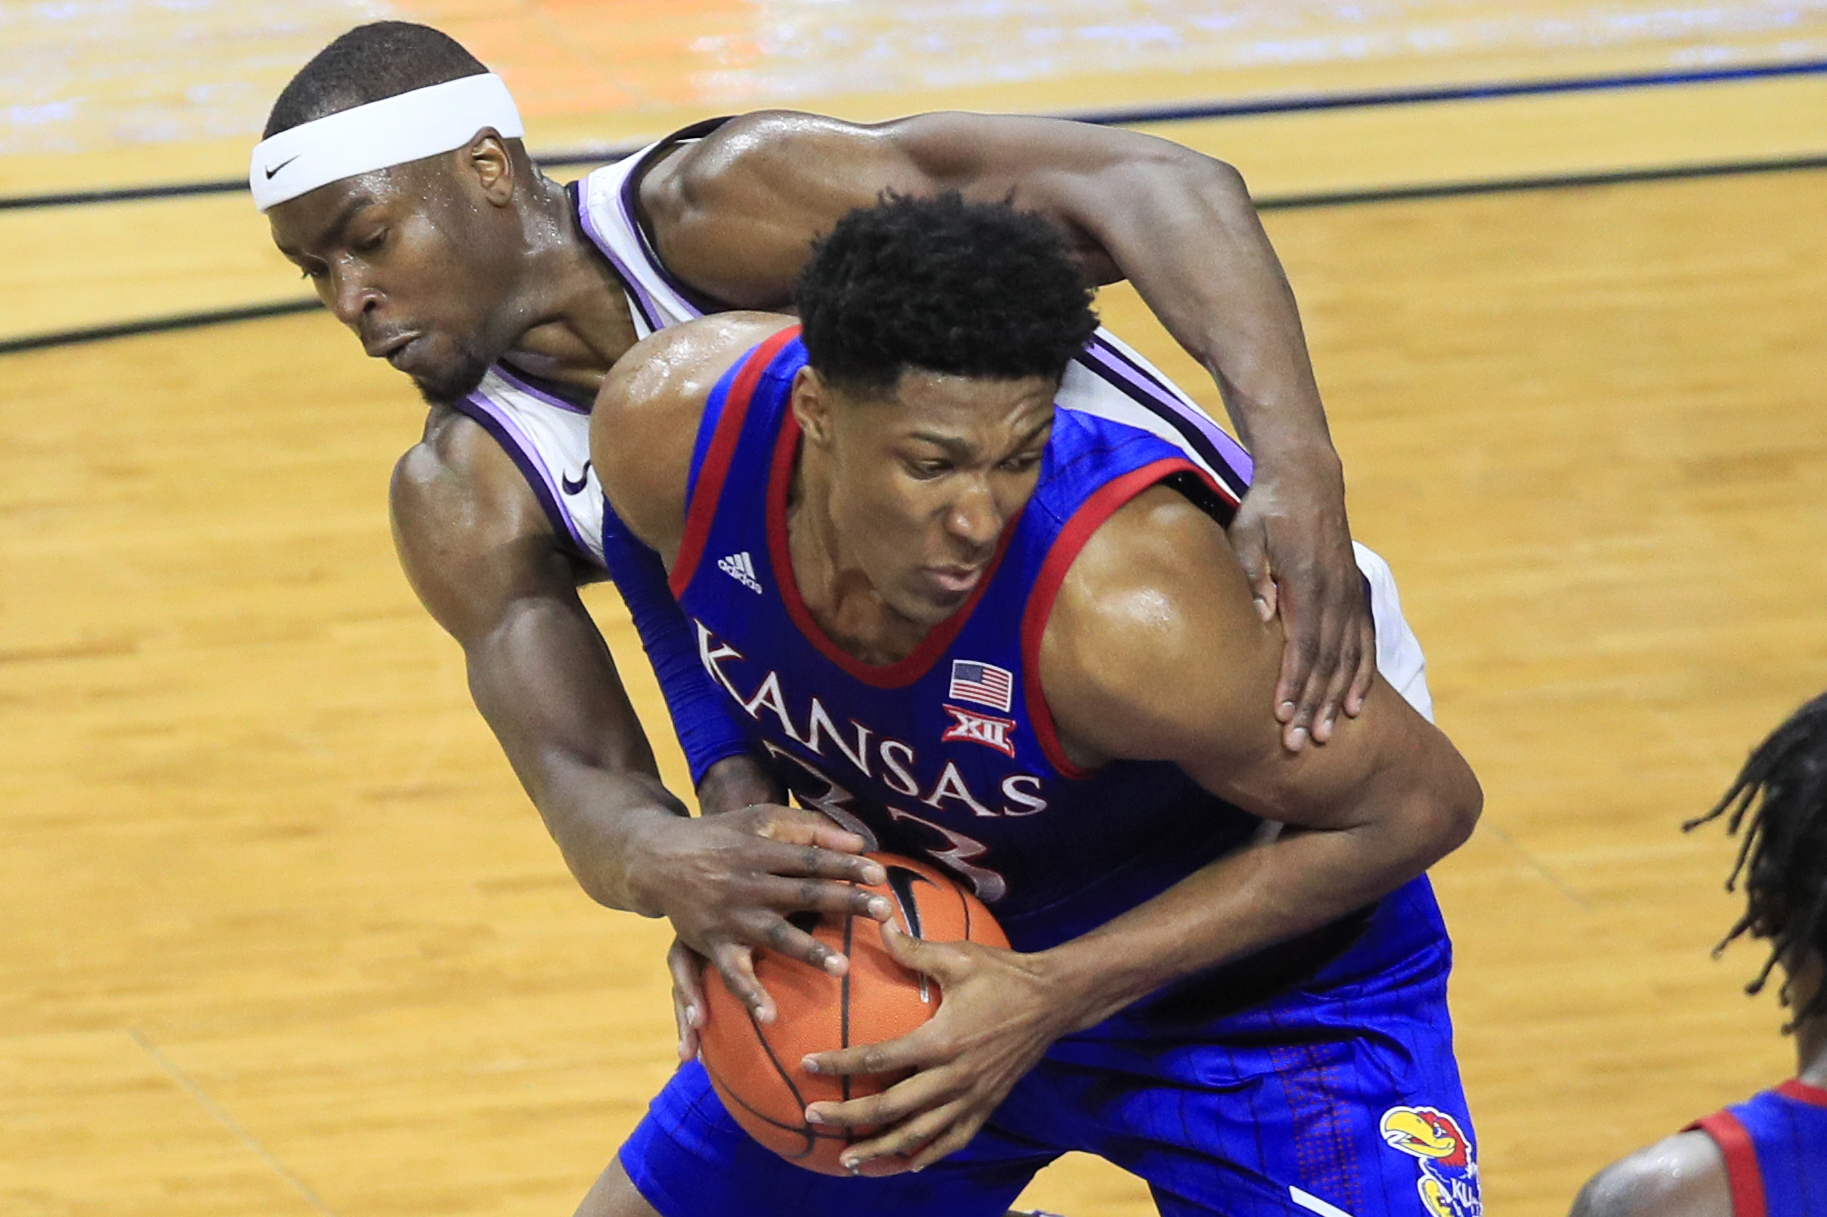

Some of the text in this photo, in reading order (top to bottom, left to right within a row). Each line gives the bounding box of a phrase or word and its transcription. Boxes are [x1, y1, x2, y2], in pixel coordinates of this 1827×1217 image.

[717, 559, 763, 595] adidas
[694, 618, 1047, 817] KANSAS
[947, 708, 1011, 752] XII
